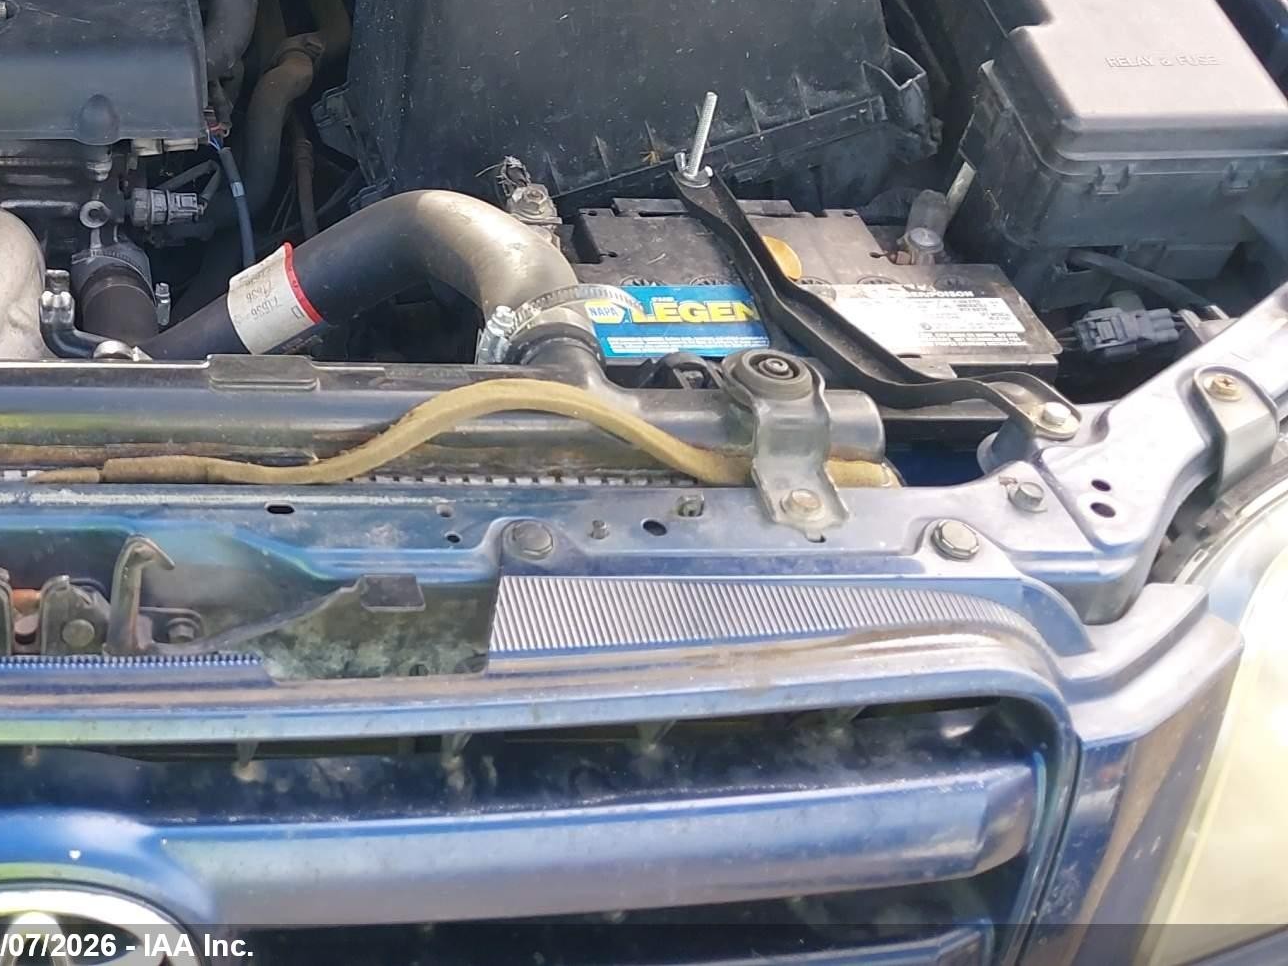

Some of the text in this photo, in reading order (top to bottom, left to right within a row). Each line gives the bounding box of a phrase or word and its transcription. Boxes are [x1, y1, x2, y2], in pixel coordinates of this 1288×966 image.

[1105, 55, 1221, 67] RELAY & FUSE
[589, 306, 618, 318] NAPA
